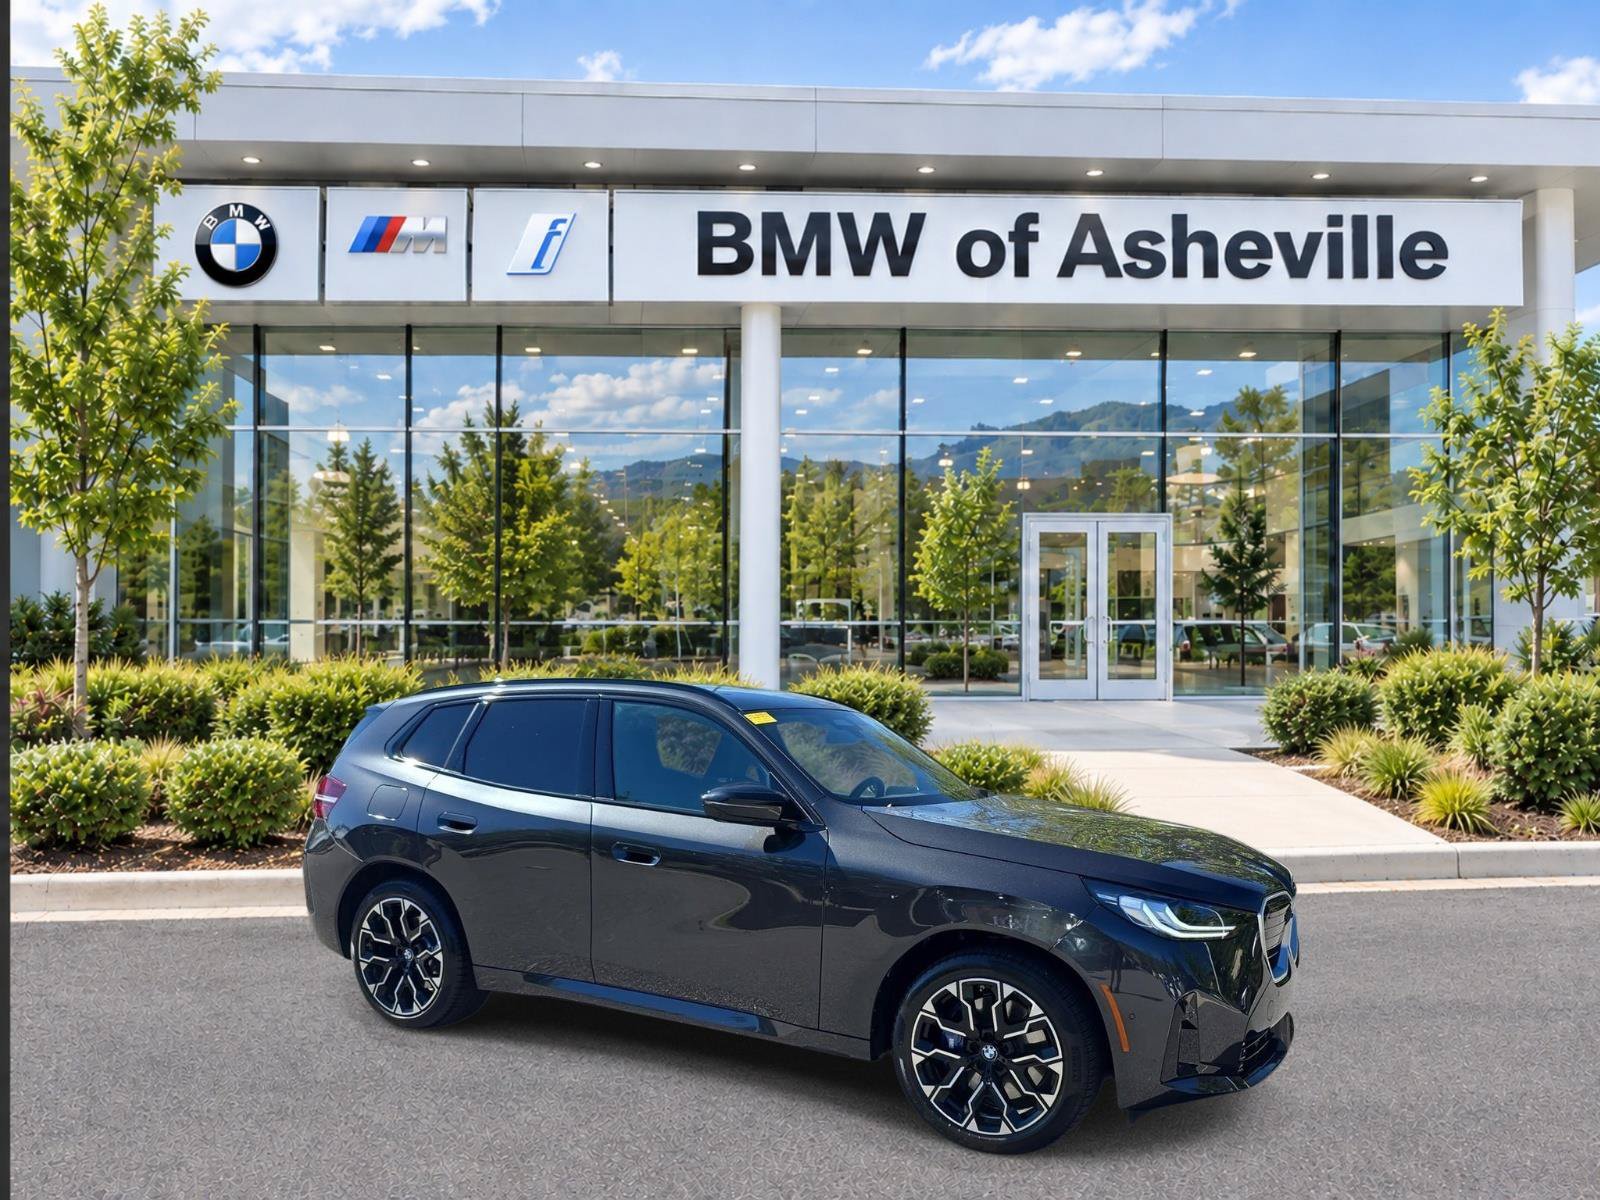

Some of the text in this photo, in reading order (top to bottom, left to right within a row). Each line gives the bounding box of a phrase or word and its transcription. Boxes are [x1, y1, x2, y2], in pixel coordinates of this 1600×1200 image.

[203, 204, 271, 231] BMW
[390, 216, 448, 254] M
[697, 210, 1449, 281] BMW of Asheville
